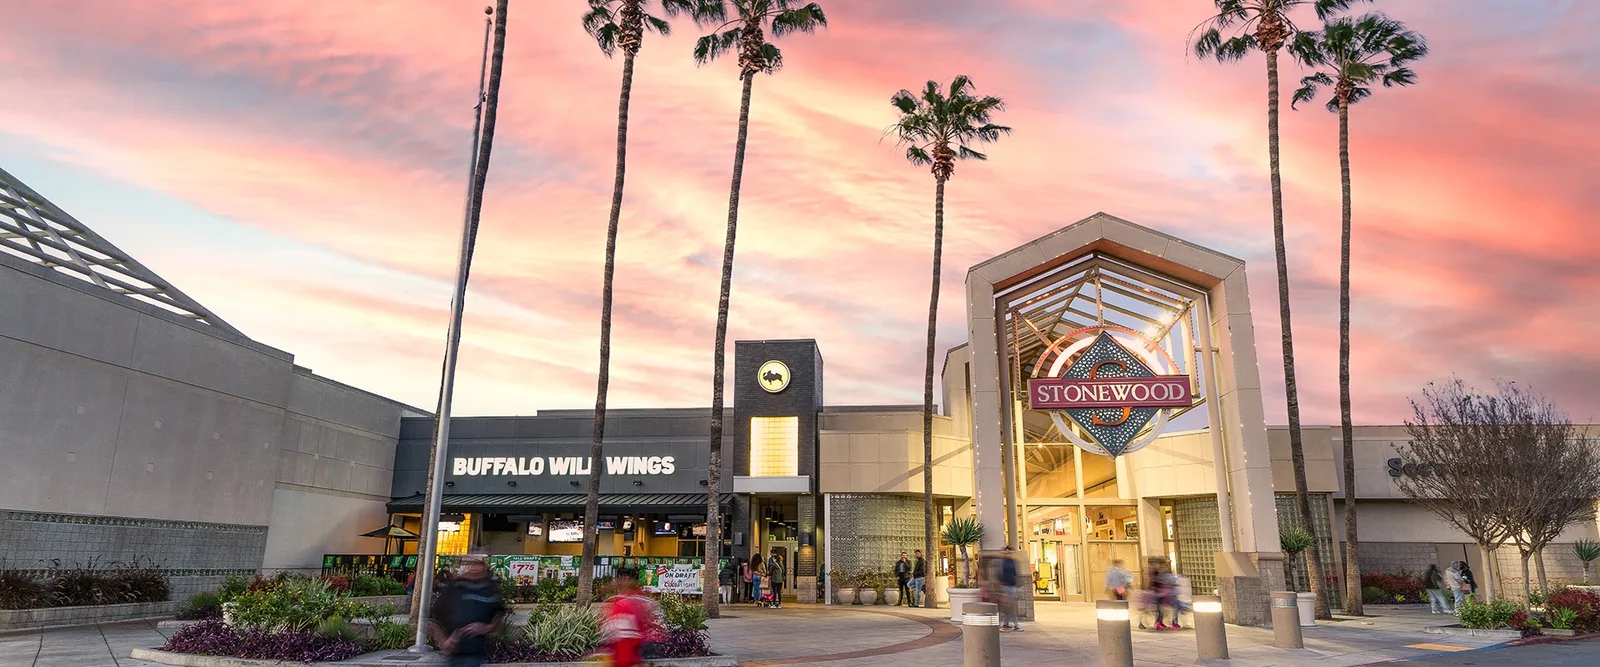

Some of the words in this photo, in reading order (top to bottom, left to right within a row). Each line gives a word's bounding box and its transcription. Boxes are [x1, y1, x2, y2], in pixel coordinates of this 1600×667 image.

[1037, 383, 1185, 403] STONEWOOD
[453, 456, 544, 476] BUFFALO
[548, 456, 592, 475] WIL
[606, 456, 675, 475] WINGS
